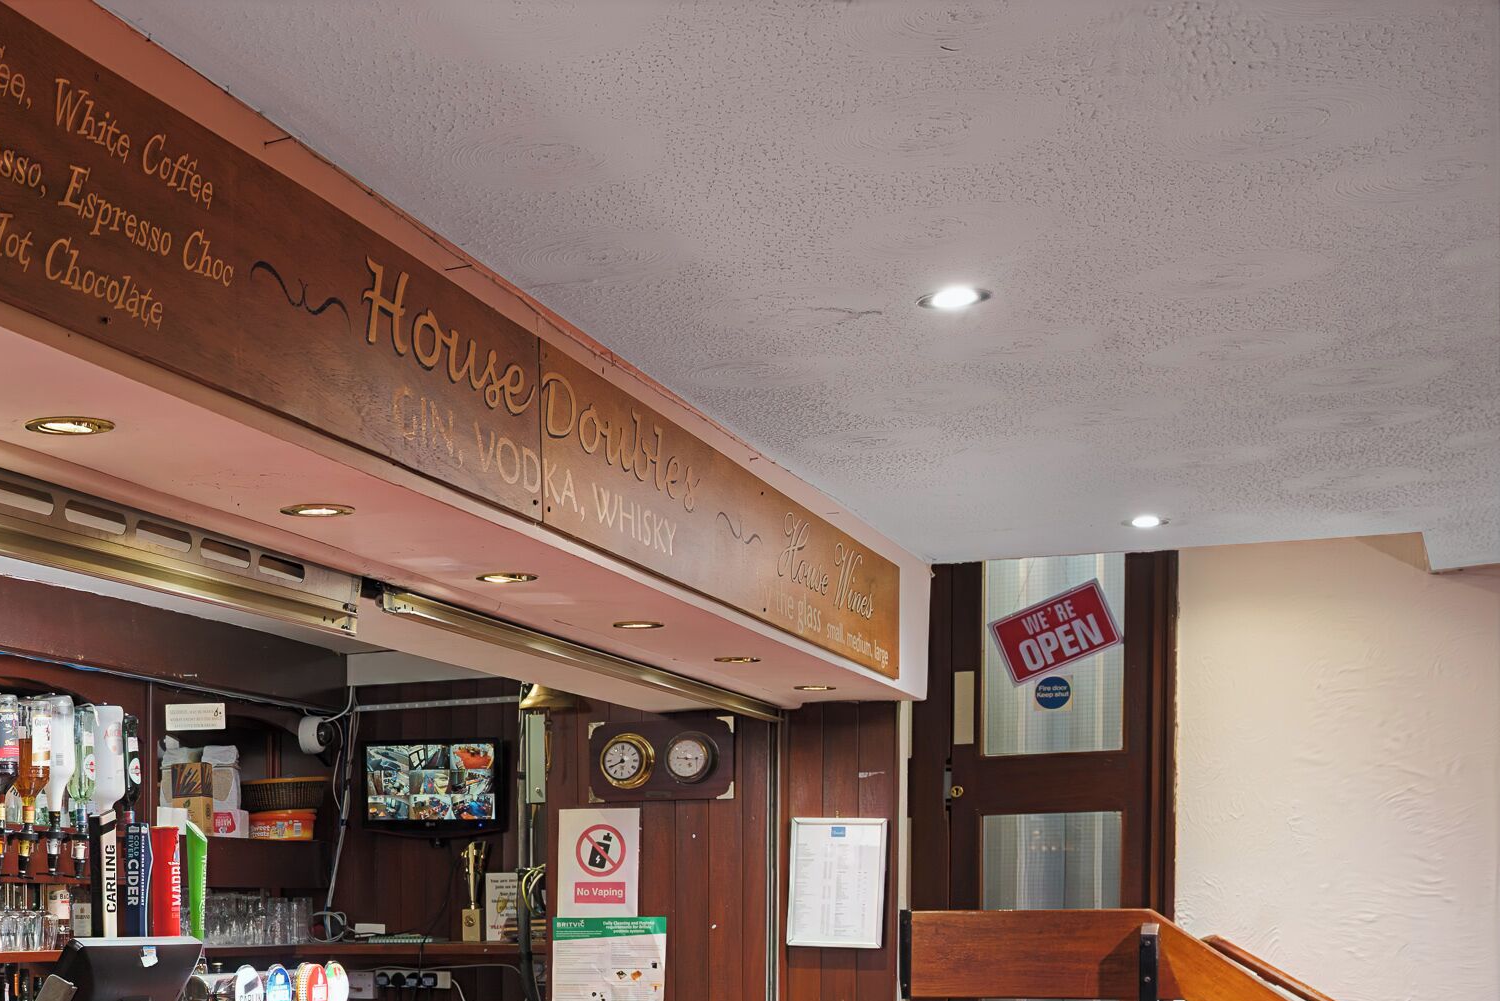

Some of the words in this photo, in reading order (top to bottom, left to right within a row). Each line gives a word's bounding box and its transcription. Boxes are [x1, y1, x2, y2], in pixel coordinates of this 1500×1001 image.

[54, 77, 132, 164] White
[142, 133, 214, 209] Coffee
[58, 164, 172, 256] Espresso
[182, 229, 234, 288] Choc
[45, 237, 164, 330] Chocolate
[362, 254, 536, 416] House
[542, 372, 700, 513] Doubles
[474, 421, 588, 523] VODKA,
[591, 483, 677, 556] WHISKY
[777, 512, 829, 596] House
[835, 543, 874, 620] Wines
[797, 594, 823, 634] glass
[1018, 613, 1104, 671] OPEN
[1021, 600, 1077, 635] WE'RE
[874, 640, 889, 669] large
[1036, 690, 1054, 699] Keep
[1054, 690, 1070, 698] shut
[1038, 684, 1052, 692] Fire
[1052, 684, 1068, 692] door
[105, 844, 117, 913] CARLING
[127, 859, 139, 906] CIDER
[576, 888, 590, 896] No
[591, 888, 624, 898] Vaping
[556, 920, 585, 928] BRITVIC
